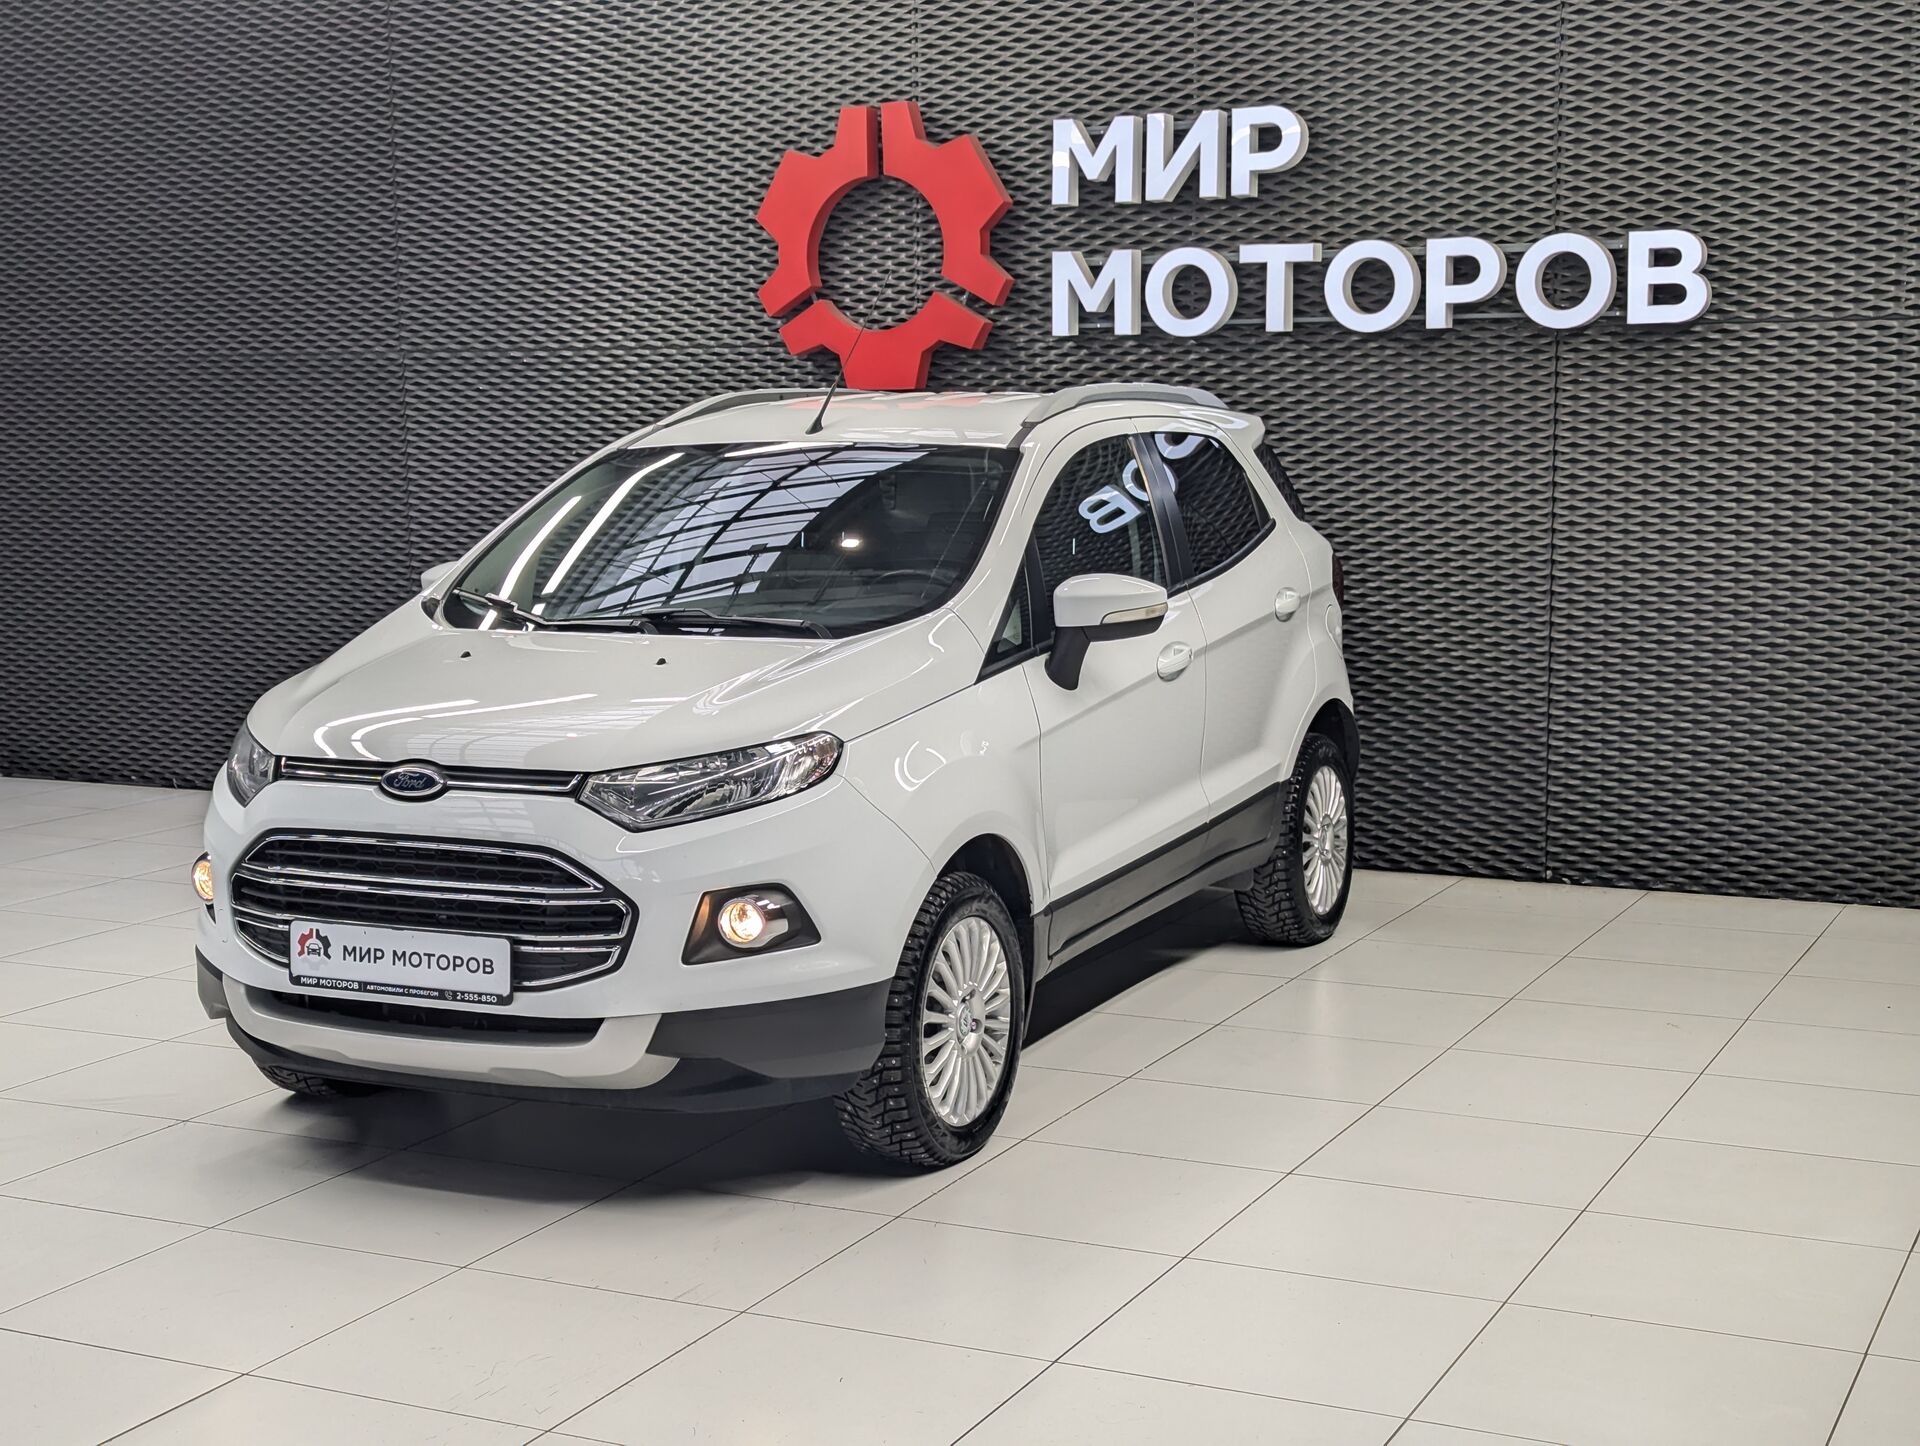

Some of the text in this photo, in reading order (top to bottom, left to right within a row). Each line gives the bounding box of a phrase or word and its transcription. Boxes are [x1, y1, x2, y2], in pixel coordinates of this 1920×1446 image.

[1052, 104, 1309, 206] МИР
[1051, 229, 1712, 338] МОТОРОВ
[393, 770, 427, 788] Ford
[342, 945, 495, 975] МИР МОТОРОВ
[300, 976, 359, 990] МИР МОТОРОВ
[456, 992, 498, 1003] 2-555-850
